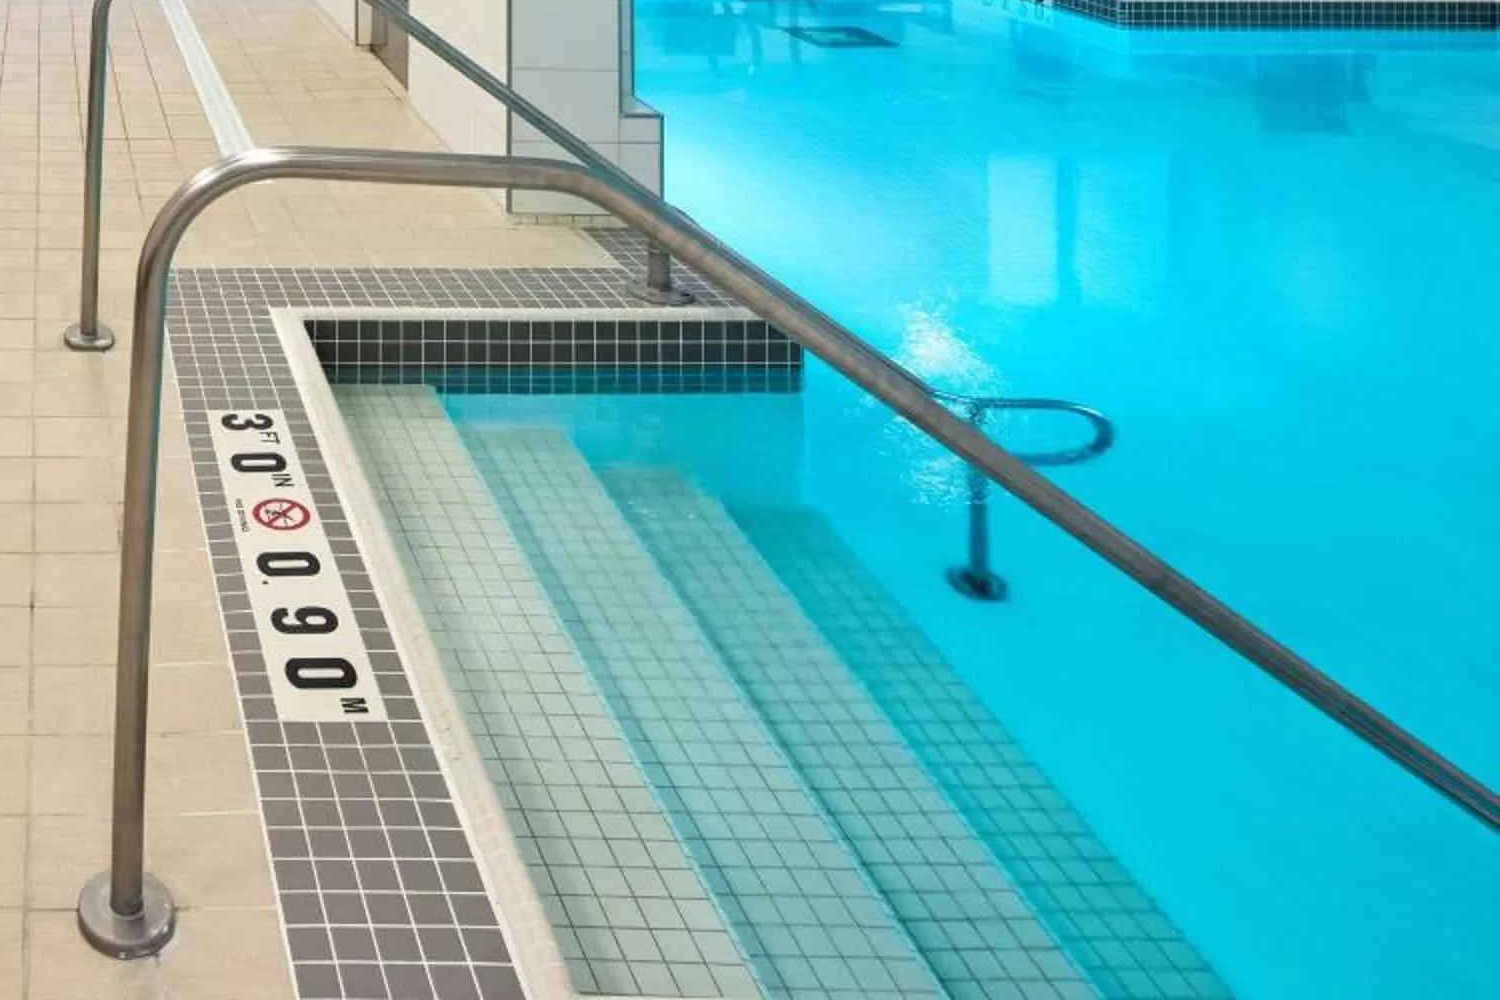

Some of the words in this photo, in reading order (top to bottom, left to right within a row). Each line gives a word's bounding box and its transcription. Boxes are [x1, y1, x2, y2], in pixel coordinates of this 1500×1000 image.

[221, 413, 273, 431] 3
[259, 431, 281, 445] FT
[230, 452, 287, 473] 0
[271, 473, 295, 488] IN
[340, 697, 369, 714] M
